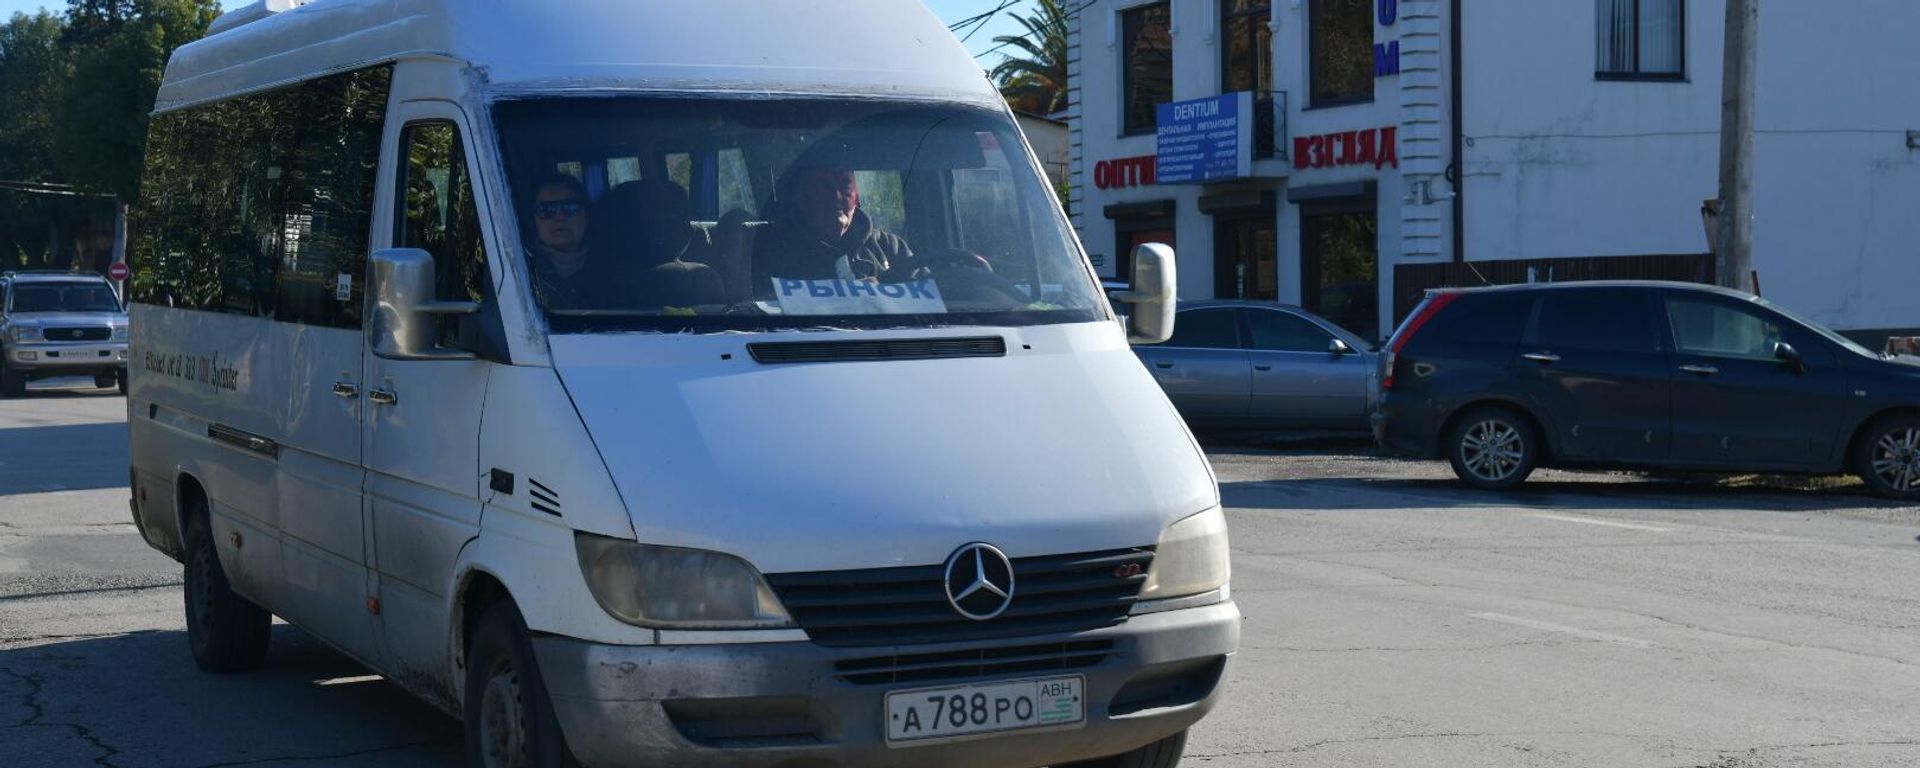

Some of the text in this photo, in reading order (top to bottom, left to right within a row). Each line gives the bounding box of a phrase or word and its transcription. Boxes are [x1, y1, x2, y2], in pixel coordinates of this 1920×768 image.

[1174, 100, 1219, 121] DENTIUM
[1293, 126, 1398, 170] ВЗГЛЯД
[779, 279, 935, 299] РЫНОК
[211, 350, 239, 395] Sprinter
